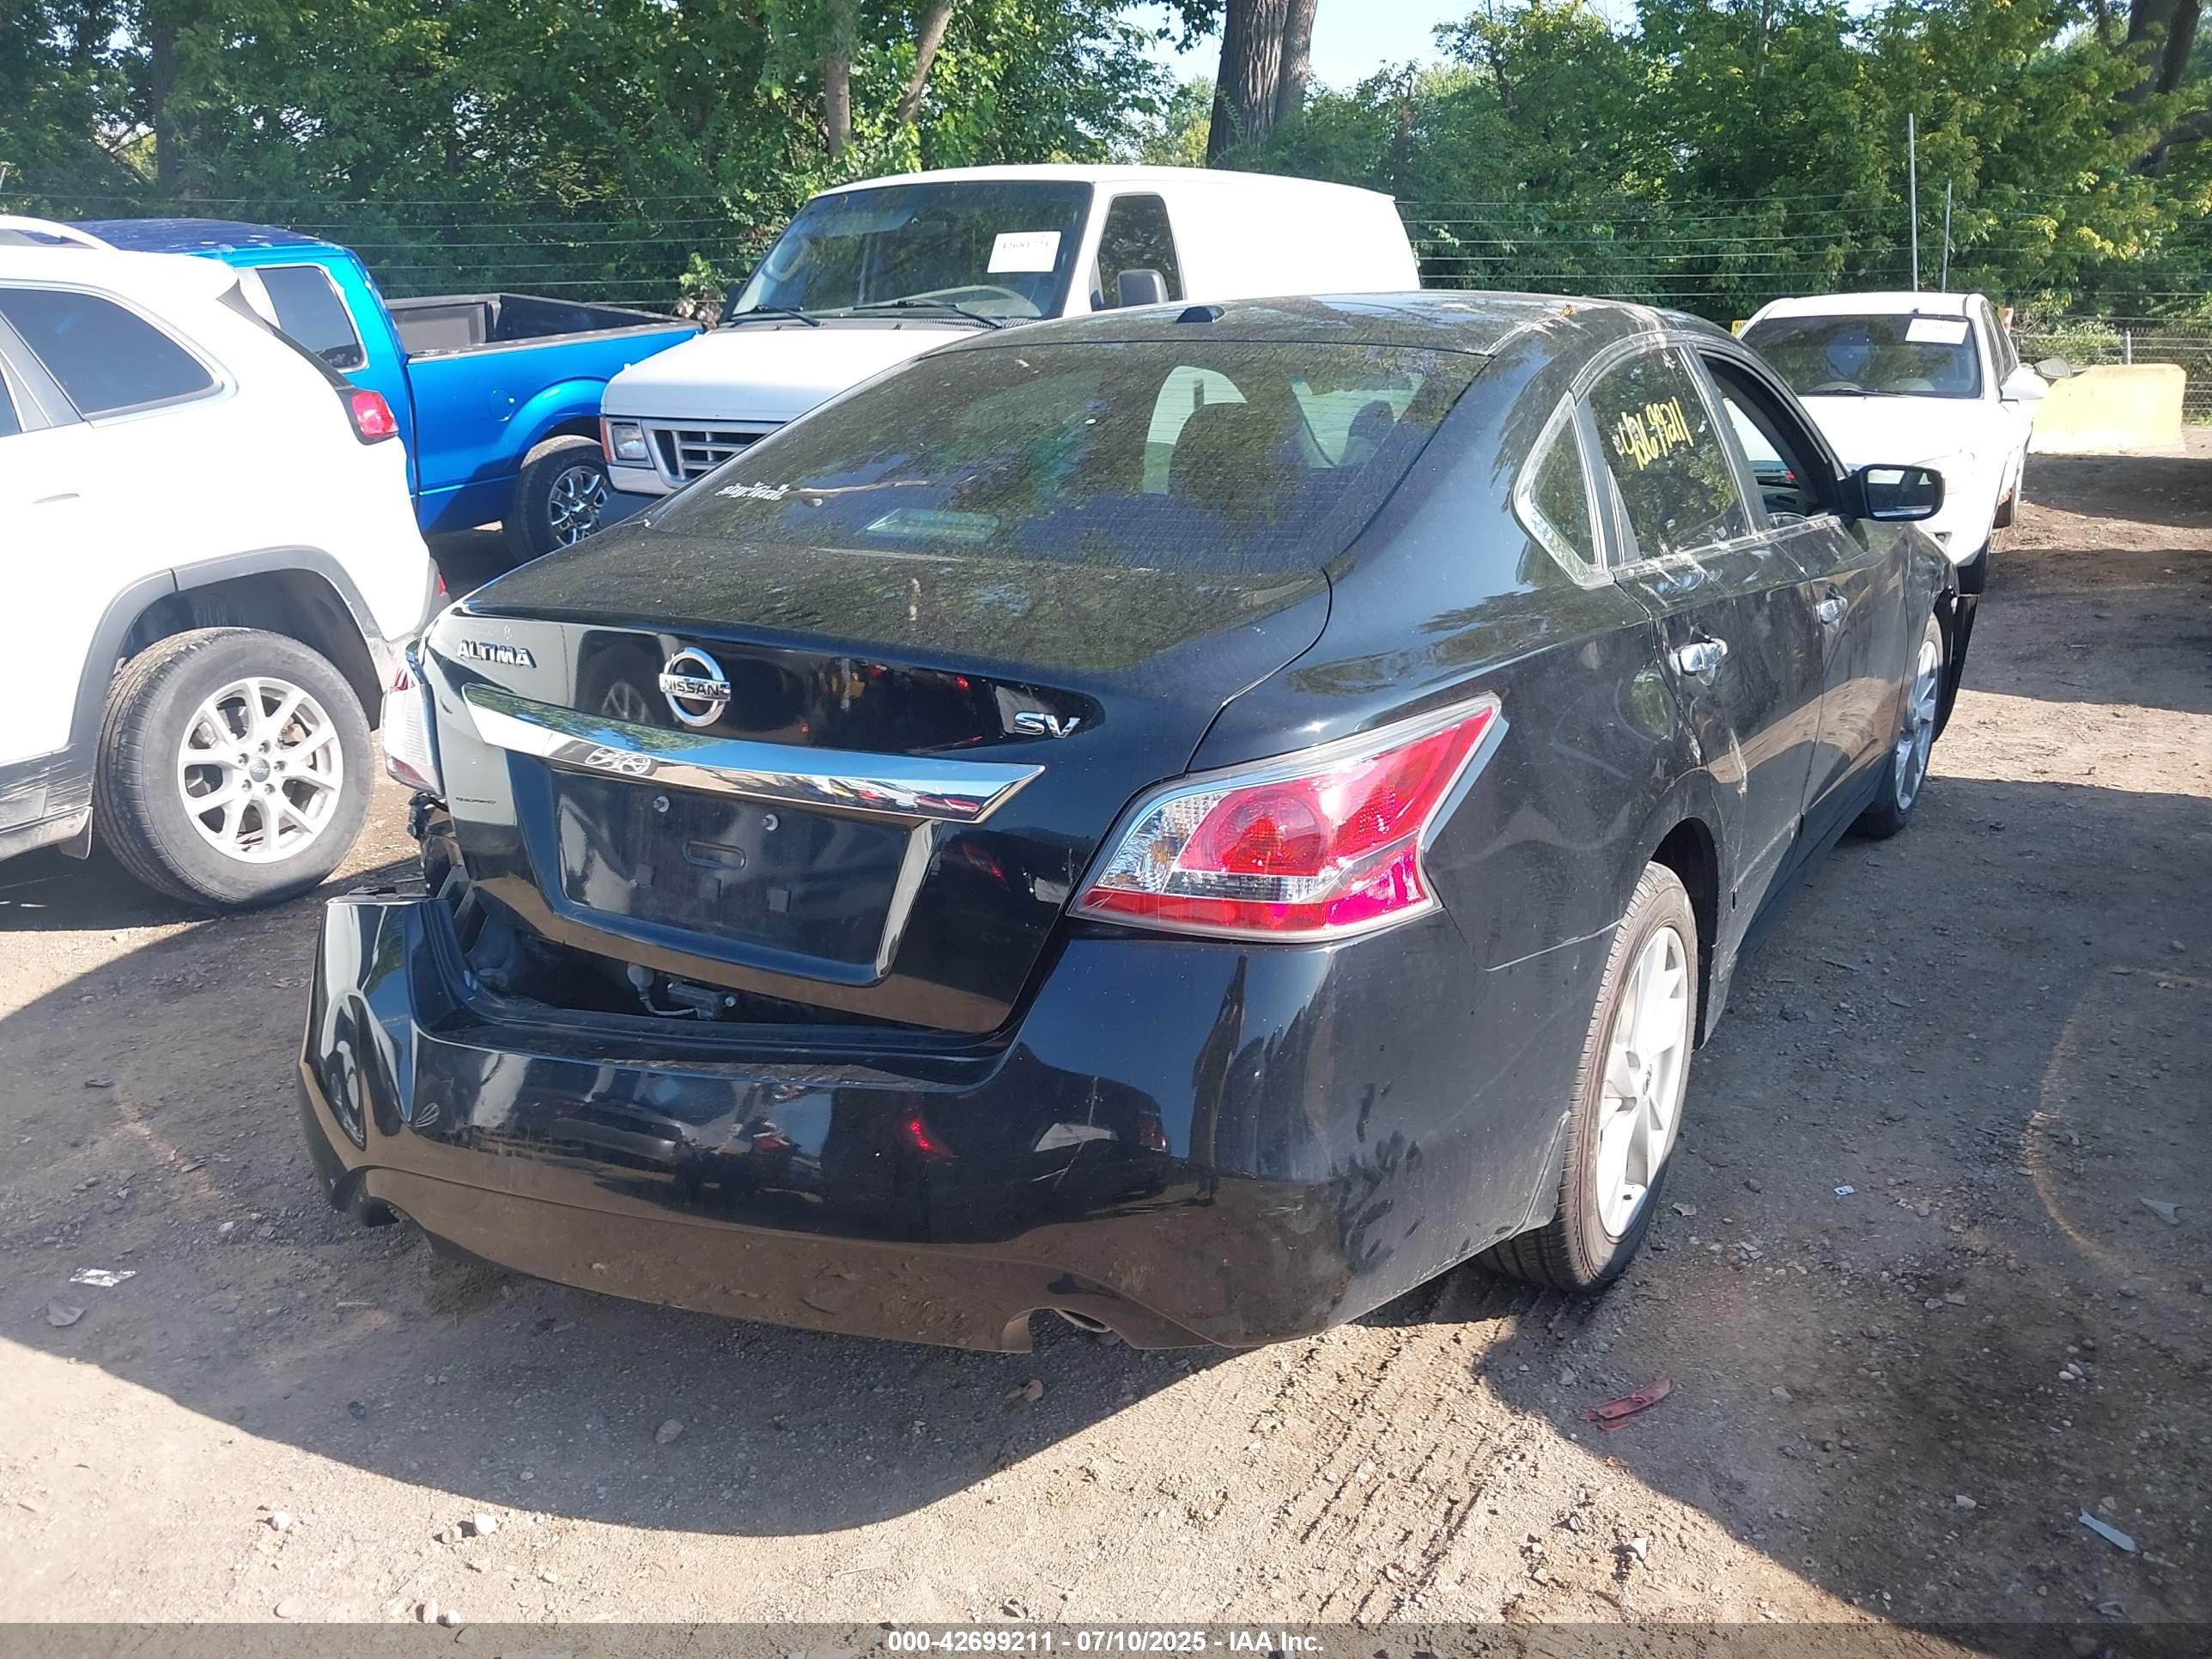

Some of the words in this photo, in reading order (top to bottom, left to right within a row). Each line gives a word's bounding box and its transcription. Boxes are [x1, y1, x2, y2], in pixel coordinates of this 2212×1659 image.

[457, 639, 538, 668] ALTIMA
[664, 678, 719, 696] NISSAN
[1014, 711, 1081, 738] SV
